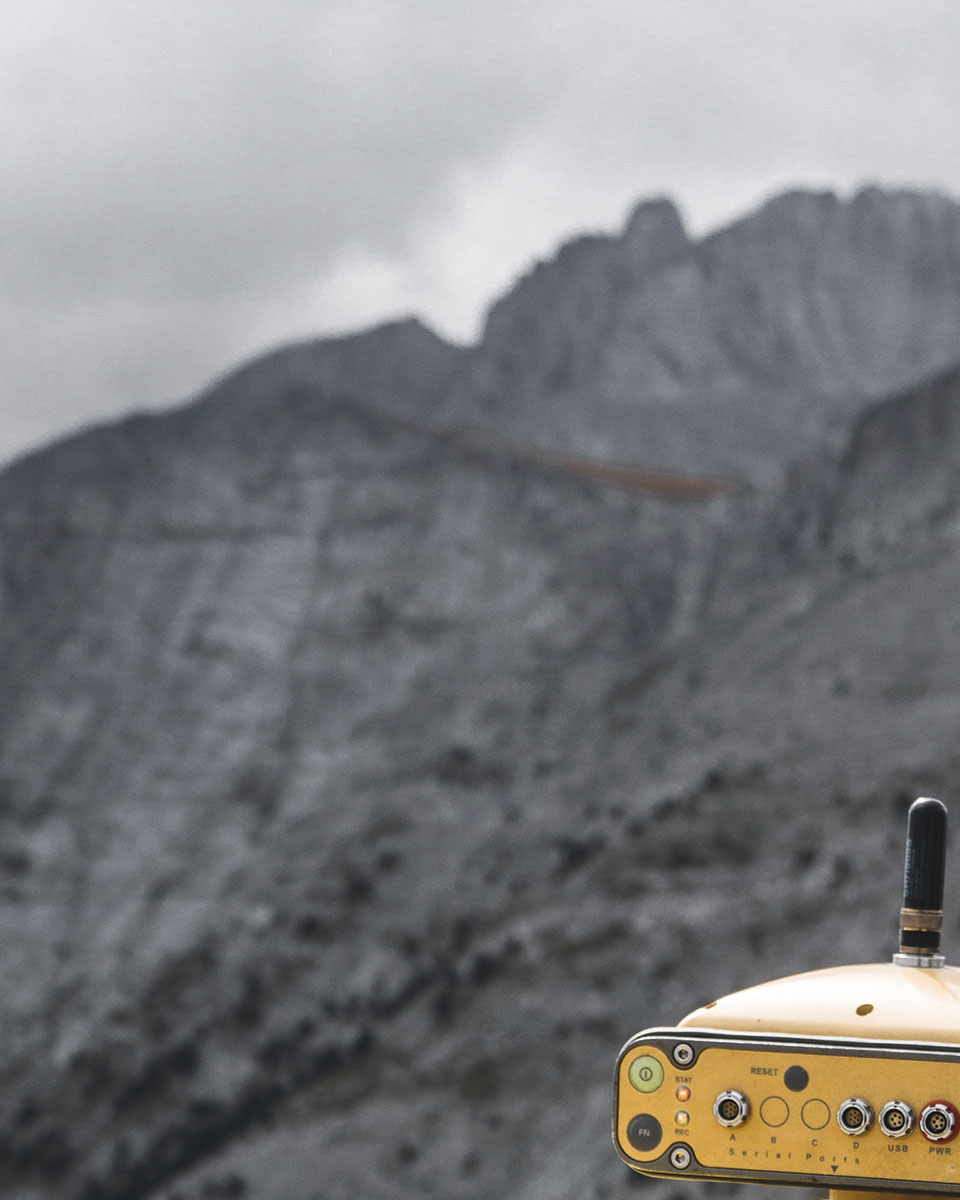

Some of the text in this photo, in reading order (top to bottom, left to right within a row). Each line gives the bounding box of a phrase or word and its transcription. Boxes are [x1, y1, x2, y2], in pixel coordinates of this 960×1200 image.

[750, 1067, 780, 1077] RESET
[674, 1076, 693, 1084] STAT
[638, 1128, 651, 1137] FN
[674, 1128, 690, 1137] REC
[729, 1133, 952, 1156] A B C D USB PWR
[728, 1147, 861, 1165] Serial Ports
